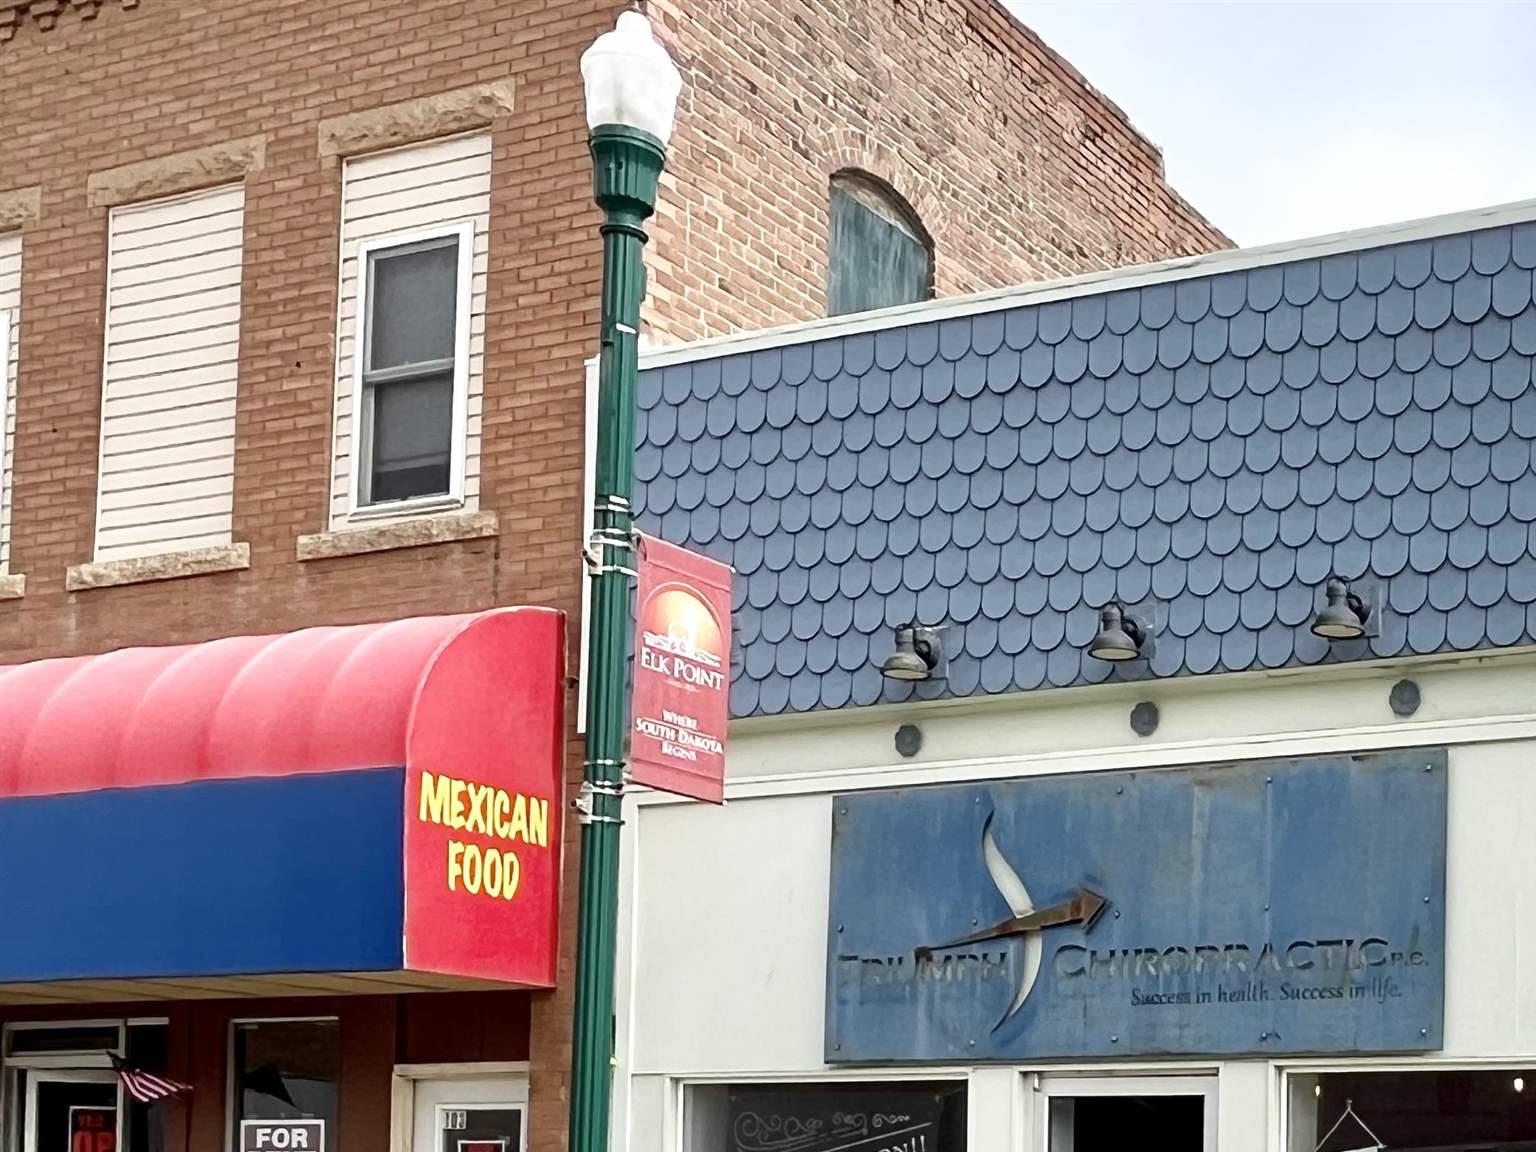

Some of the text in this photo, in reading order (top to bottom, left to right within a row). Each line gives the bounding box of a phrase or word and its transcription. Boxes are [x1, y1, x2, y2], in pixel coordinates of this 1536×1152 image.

[640, 645, 725, 691] ELK POINT
[635, 717, 724, 754] SOUTH DAKOTA
[419, 770, 549, 848] MEXICAN
[448, 839, 520, 901] FOOD
[1054, 937, 1389, 977] CHIROPRACTIC
[1131, 987, 1191, 1006] Success
[1196, 986, 1211, 1003] in
[1280, 981, 1344, 1000] Success
[256, 1127, 308, 1148] FOR
[445, 1111, 466, 1129] 103
